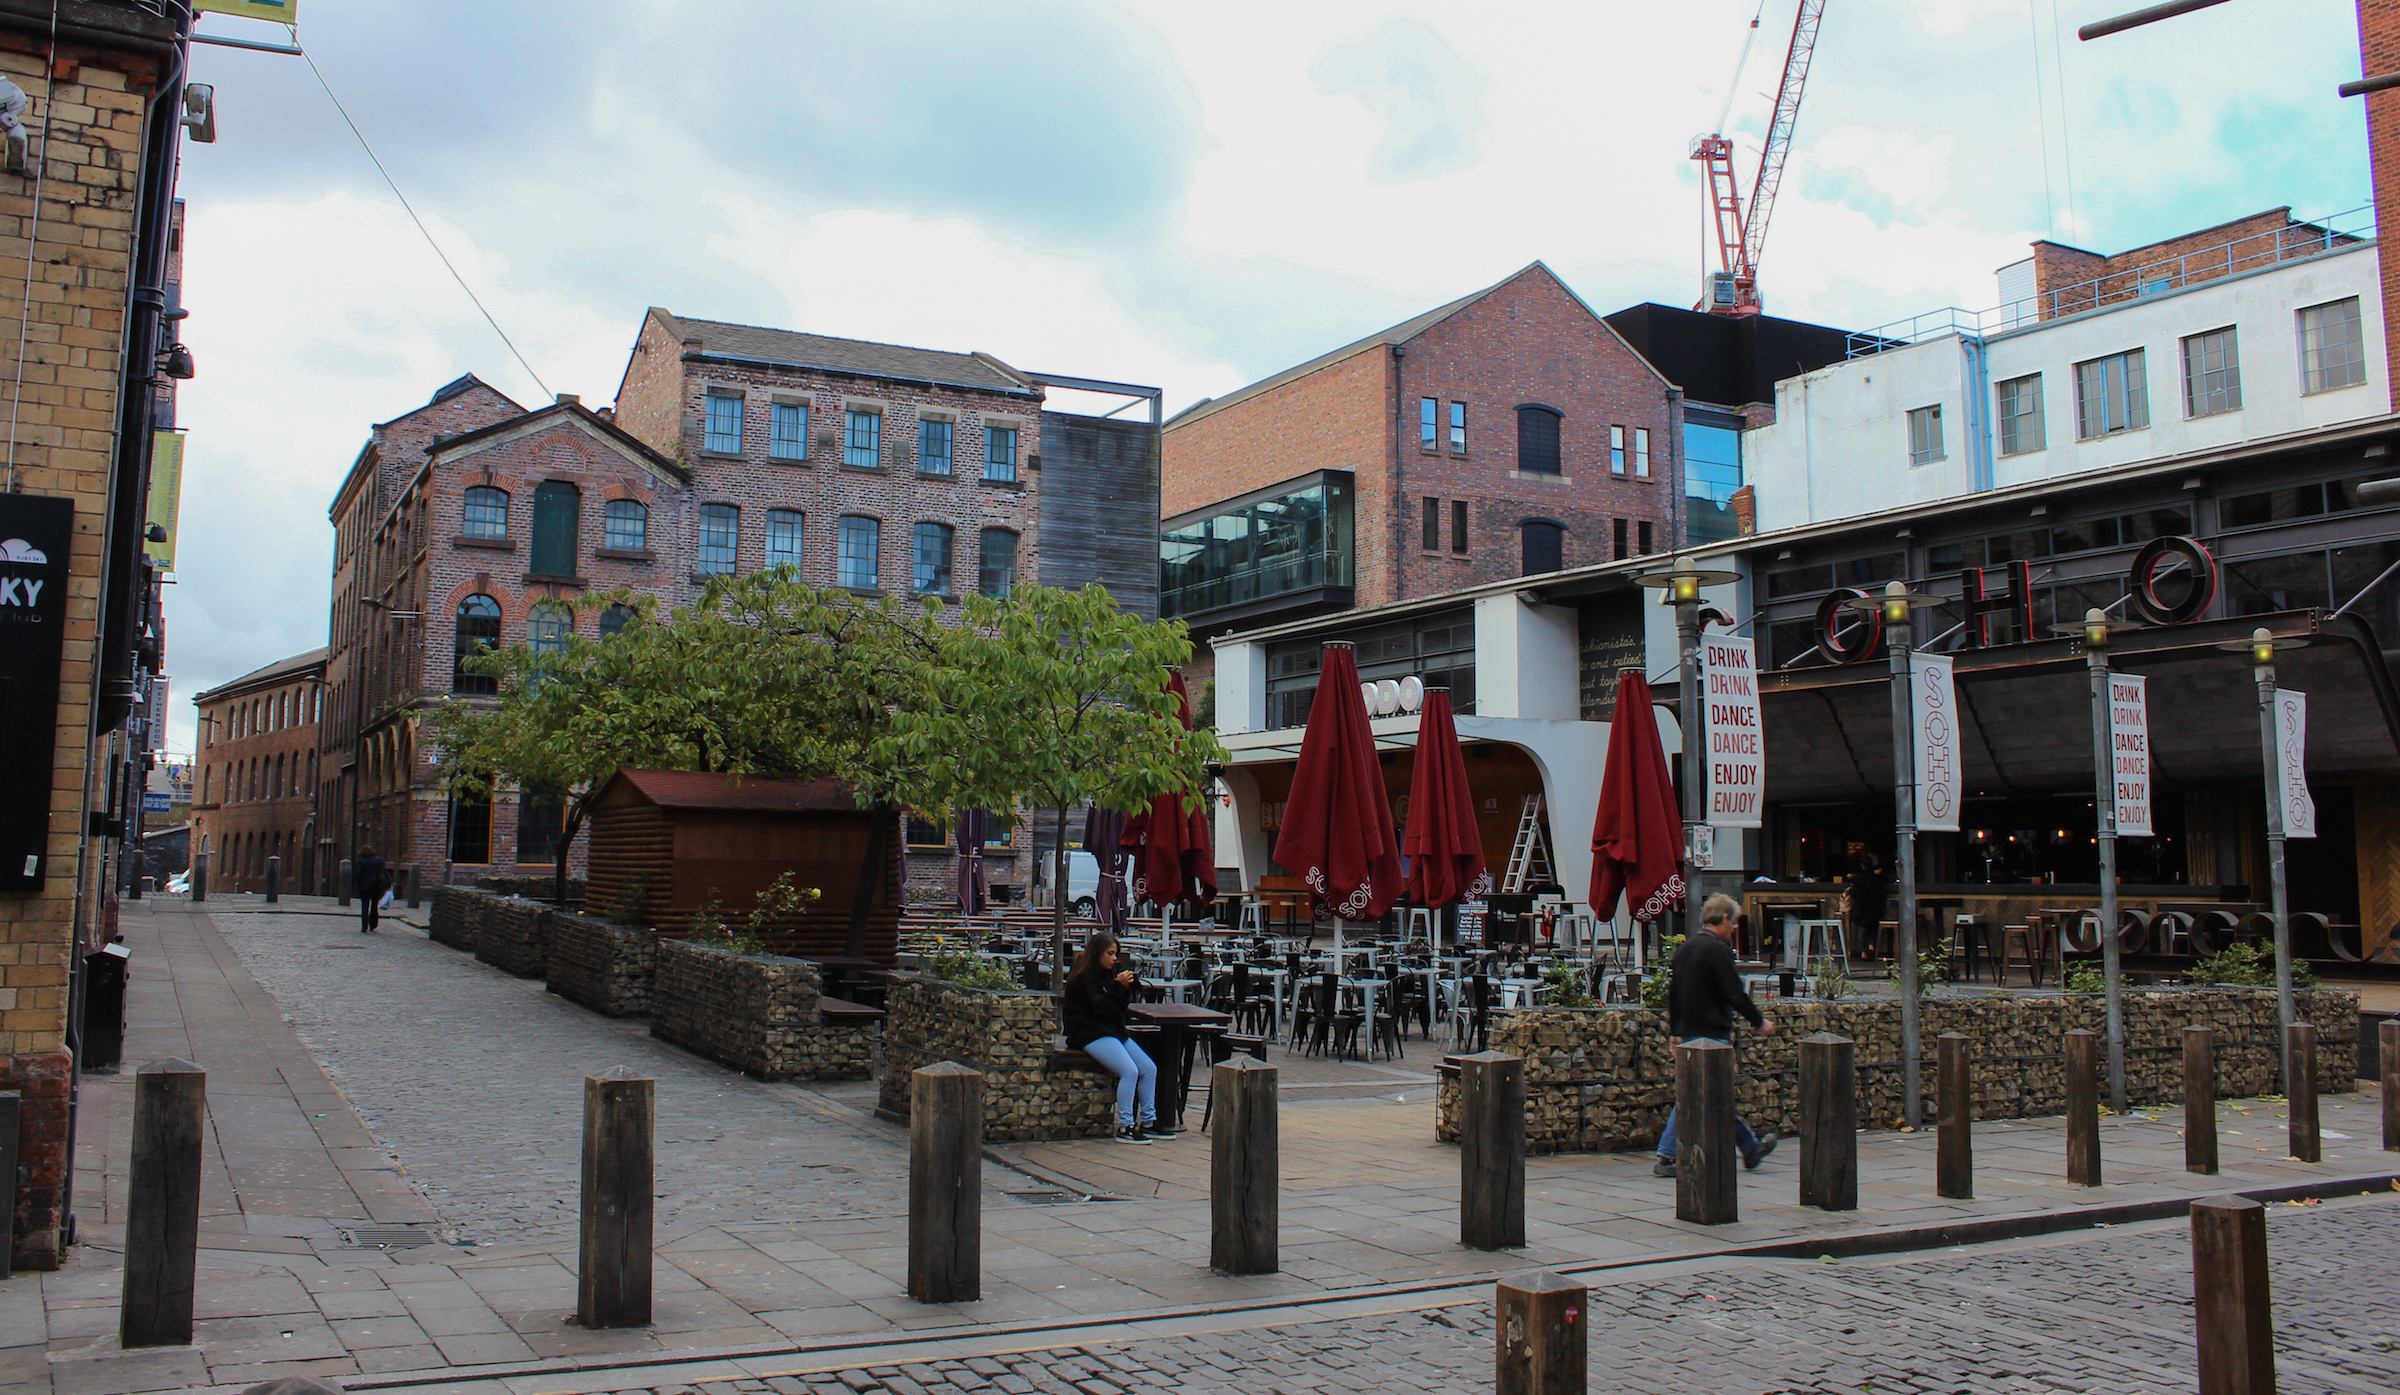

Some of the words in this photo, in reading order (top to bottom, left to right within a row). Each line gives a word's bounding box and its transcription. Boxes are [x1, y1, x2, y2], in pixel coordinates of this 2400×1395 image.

[170, 440, 181, 470] Flexible
[168, 471, 178, 495] leases
[166, 497, 177, 532] available
[1699, 535, 2217, 665] OHO
[1708, 646, 1750, 670] DRINK
[1710, 673, 1752, 697] DRINK
[2113, 684, 2141, 704] DRINK
[153, 686, 164, 744] WETHERSPOON
[1712, 704, 1756, 727] DANCE
[2114, 707, 2143, 726] DRINK
[1713, 732, 1758, 755] DANCE
[1924, 666, 1951, 819] SOHO
[2115, 733, 2144, 752] DANCE
[1715, 763, 1757, 786] ENJOY
[2116, 756, 2146, 775] DANCE
[2284, 700, 2307, 828] SOHO
[1714, 792, 1756, 813] ENJOY
[2118, 782, 2146, 800] ENJOY
[2119, 805, 2147, 824] ENJOY
